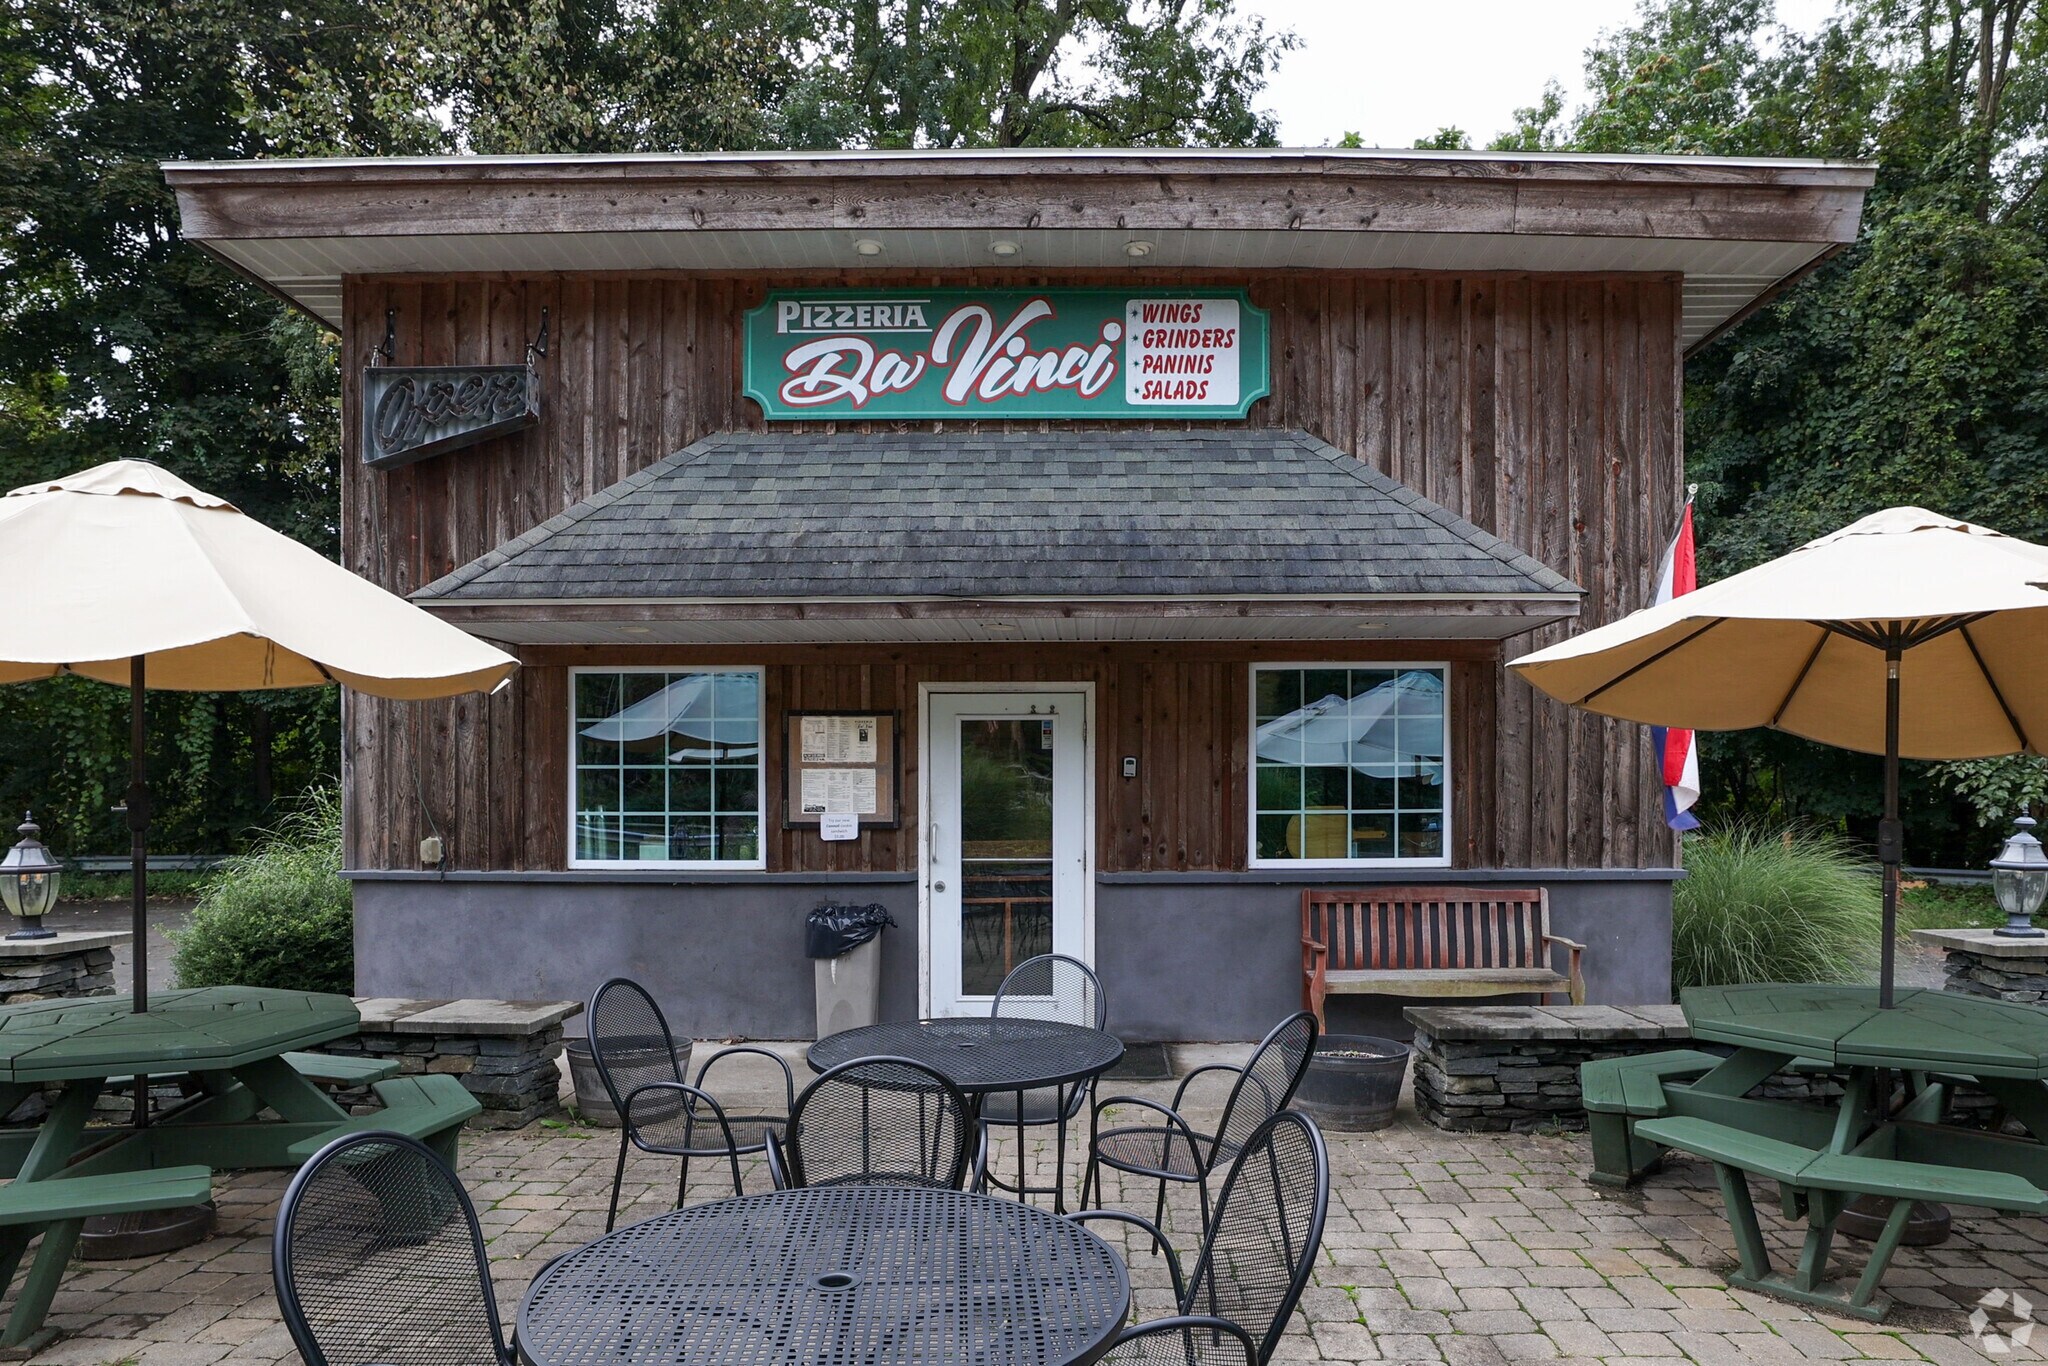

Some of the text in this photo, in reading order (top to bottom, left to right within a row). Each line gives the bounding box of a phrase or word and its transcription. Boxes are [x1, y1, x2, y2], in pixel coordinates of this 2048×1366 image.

[777, 300, 928, 333] PIZZERIA
[1142, 303, 1203, 324] WINGS
[1142, 328, 1236, 349] GRINDERS
[781, 299, 1122, 406] Da Vinci
[1142, 354, 1215, 374] PANINIS
[1142, 380, 1209, 400] SALADS
